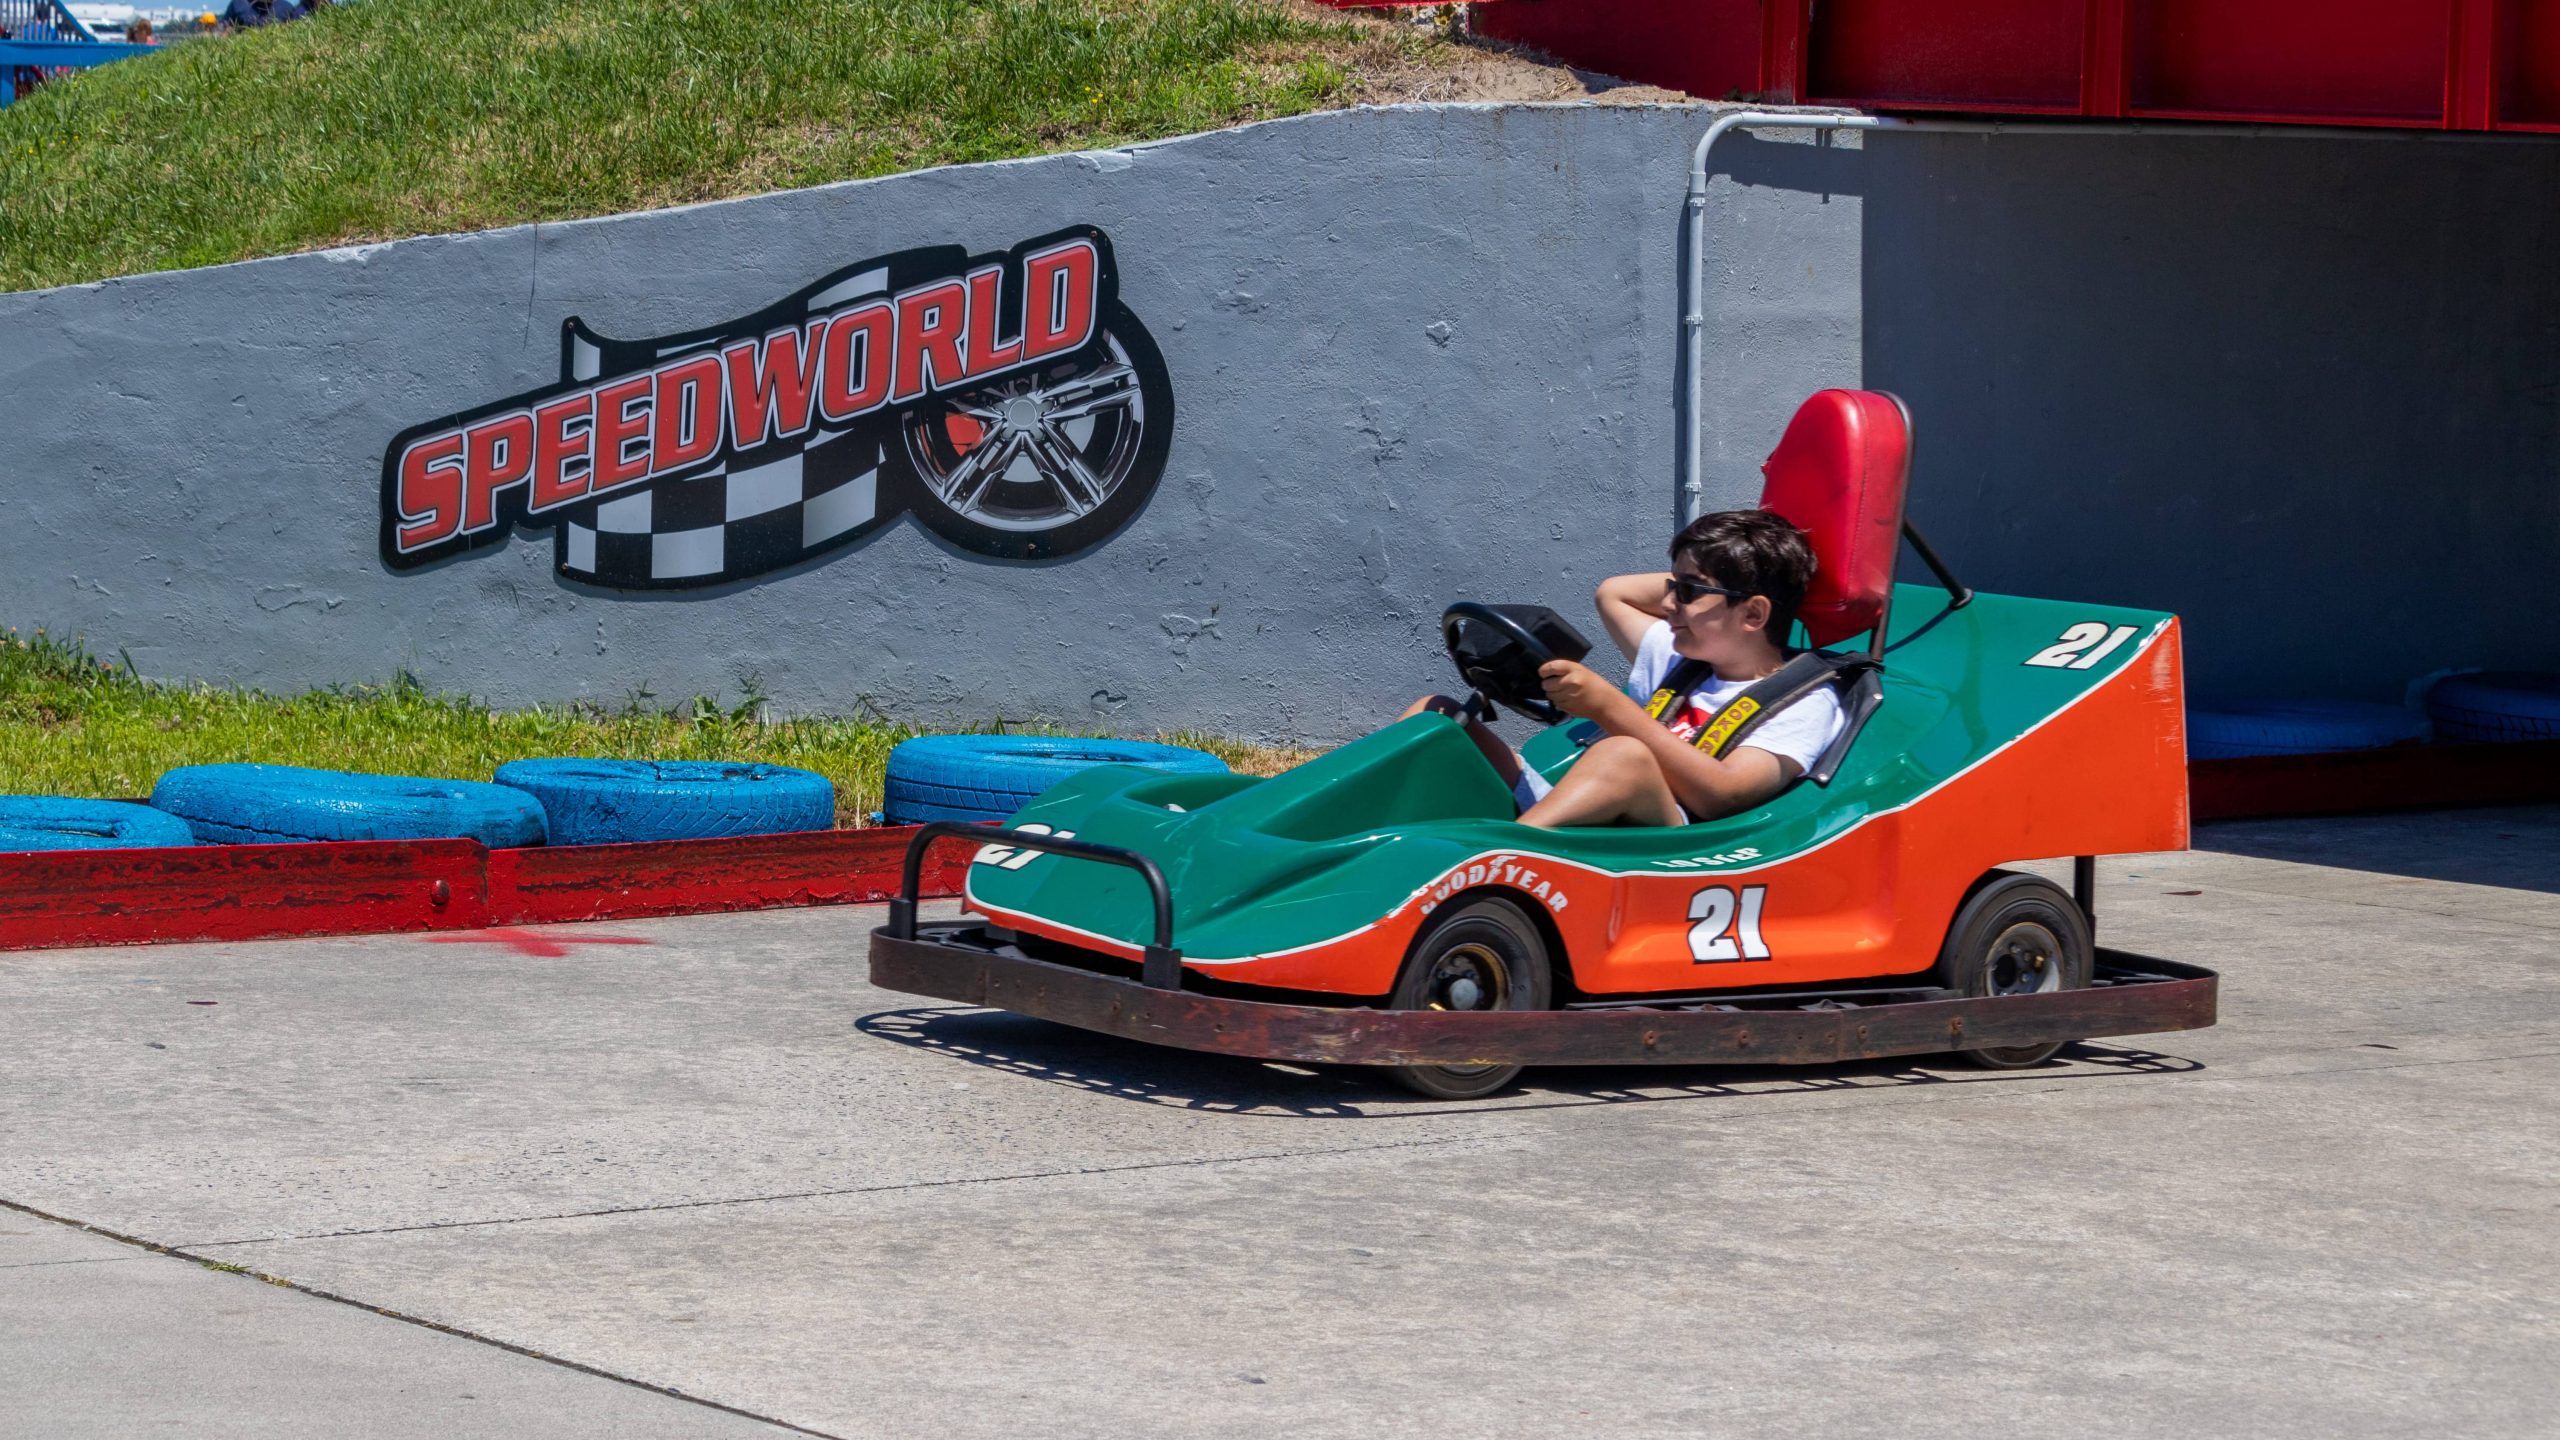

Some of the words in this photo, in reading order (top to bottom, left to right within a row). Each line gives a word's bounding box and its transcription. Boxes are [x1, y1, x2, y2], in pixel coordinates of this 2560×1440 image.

[398, 238, 1098, 554] SPEEDWORLD
[2021, 620, 2142, 671] 21
[1700, 699, 1754, 757] GOKAR
[1686, 884, 1772, 965] 21
